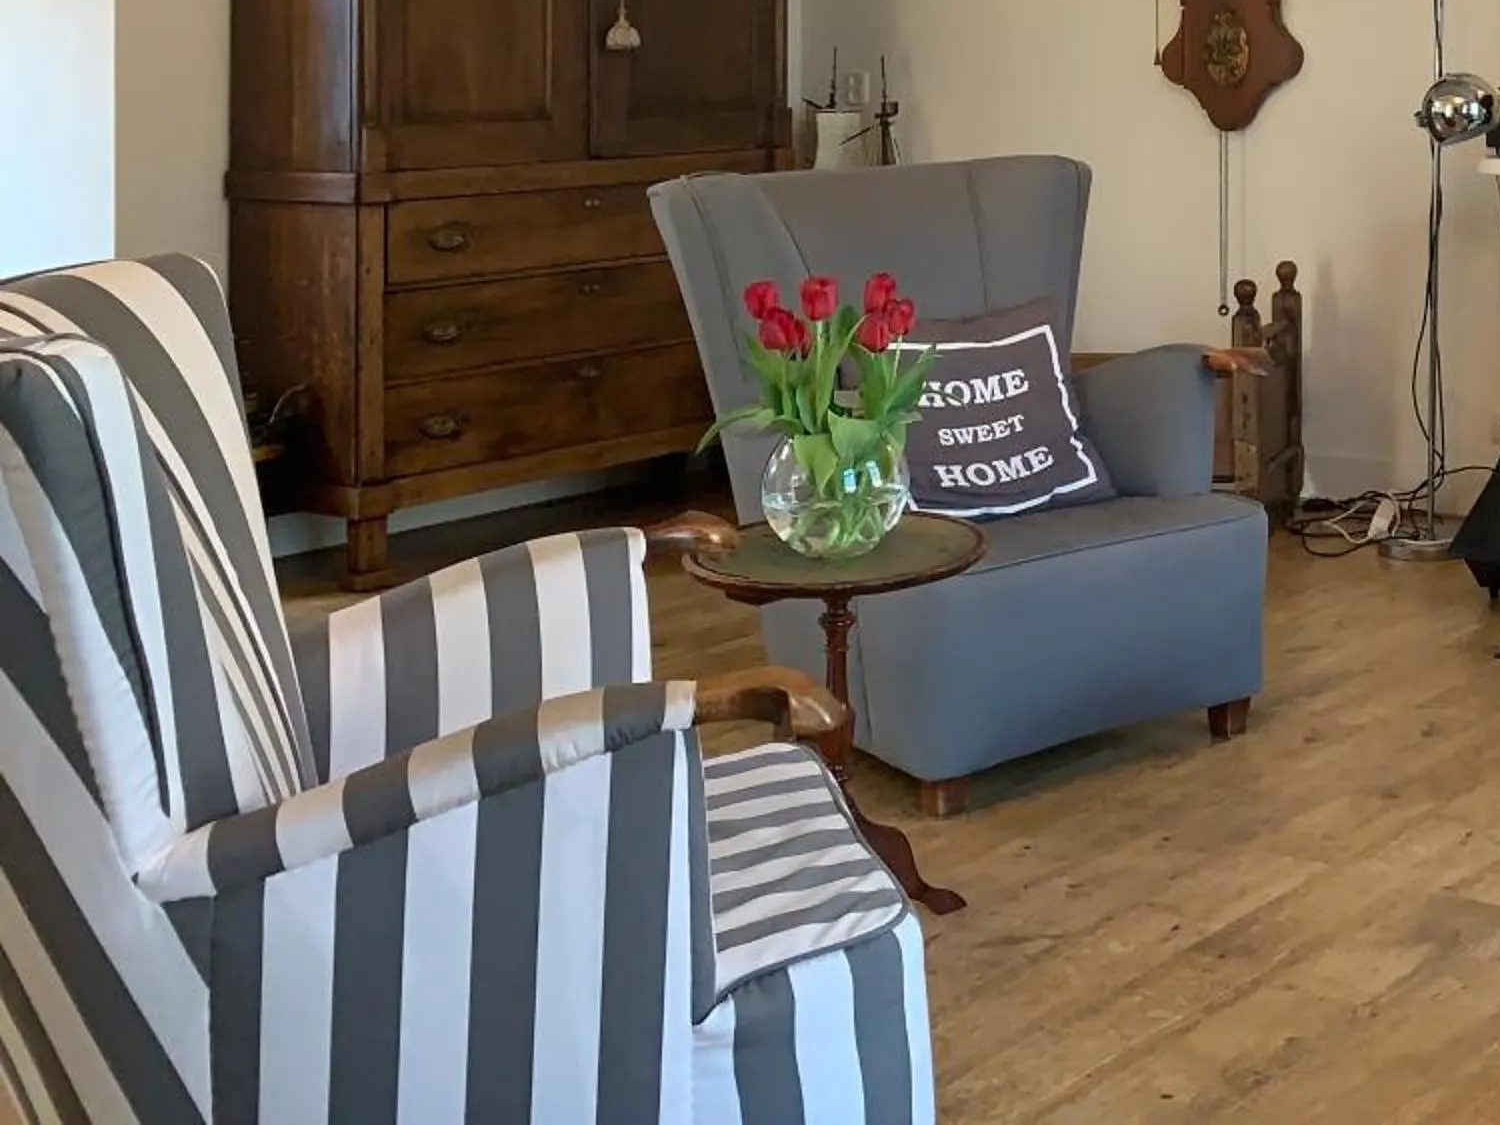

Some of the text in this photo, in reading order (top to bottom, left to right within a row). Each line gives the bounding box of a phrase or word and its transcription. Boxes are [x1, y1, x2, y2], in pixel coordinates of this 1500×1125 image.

[917, 368, 1030, 408] HOME
[937, 414, 1026, 447] SWEET
[932, 445, 1055, 489] HOME
